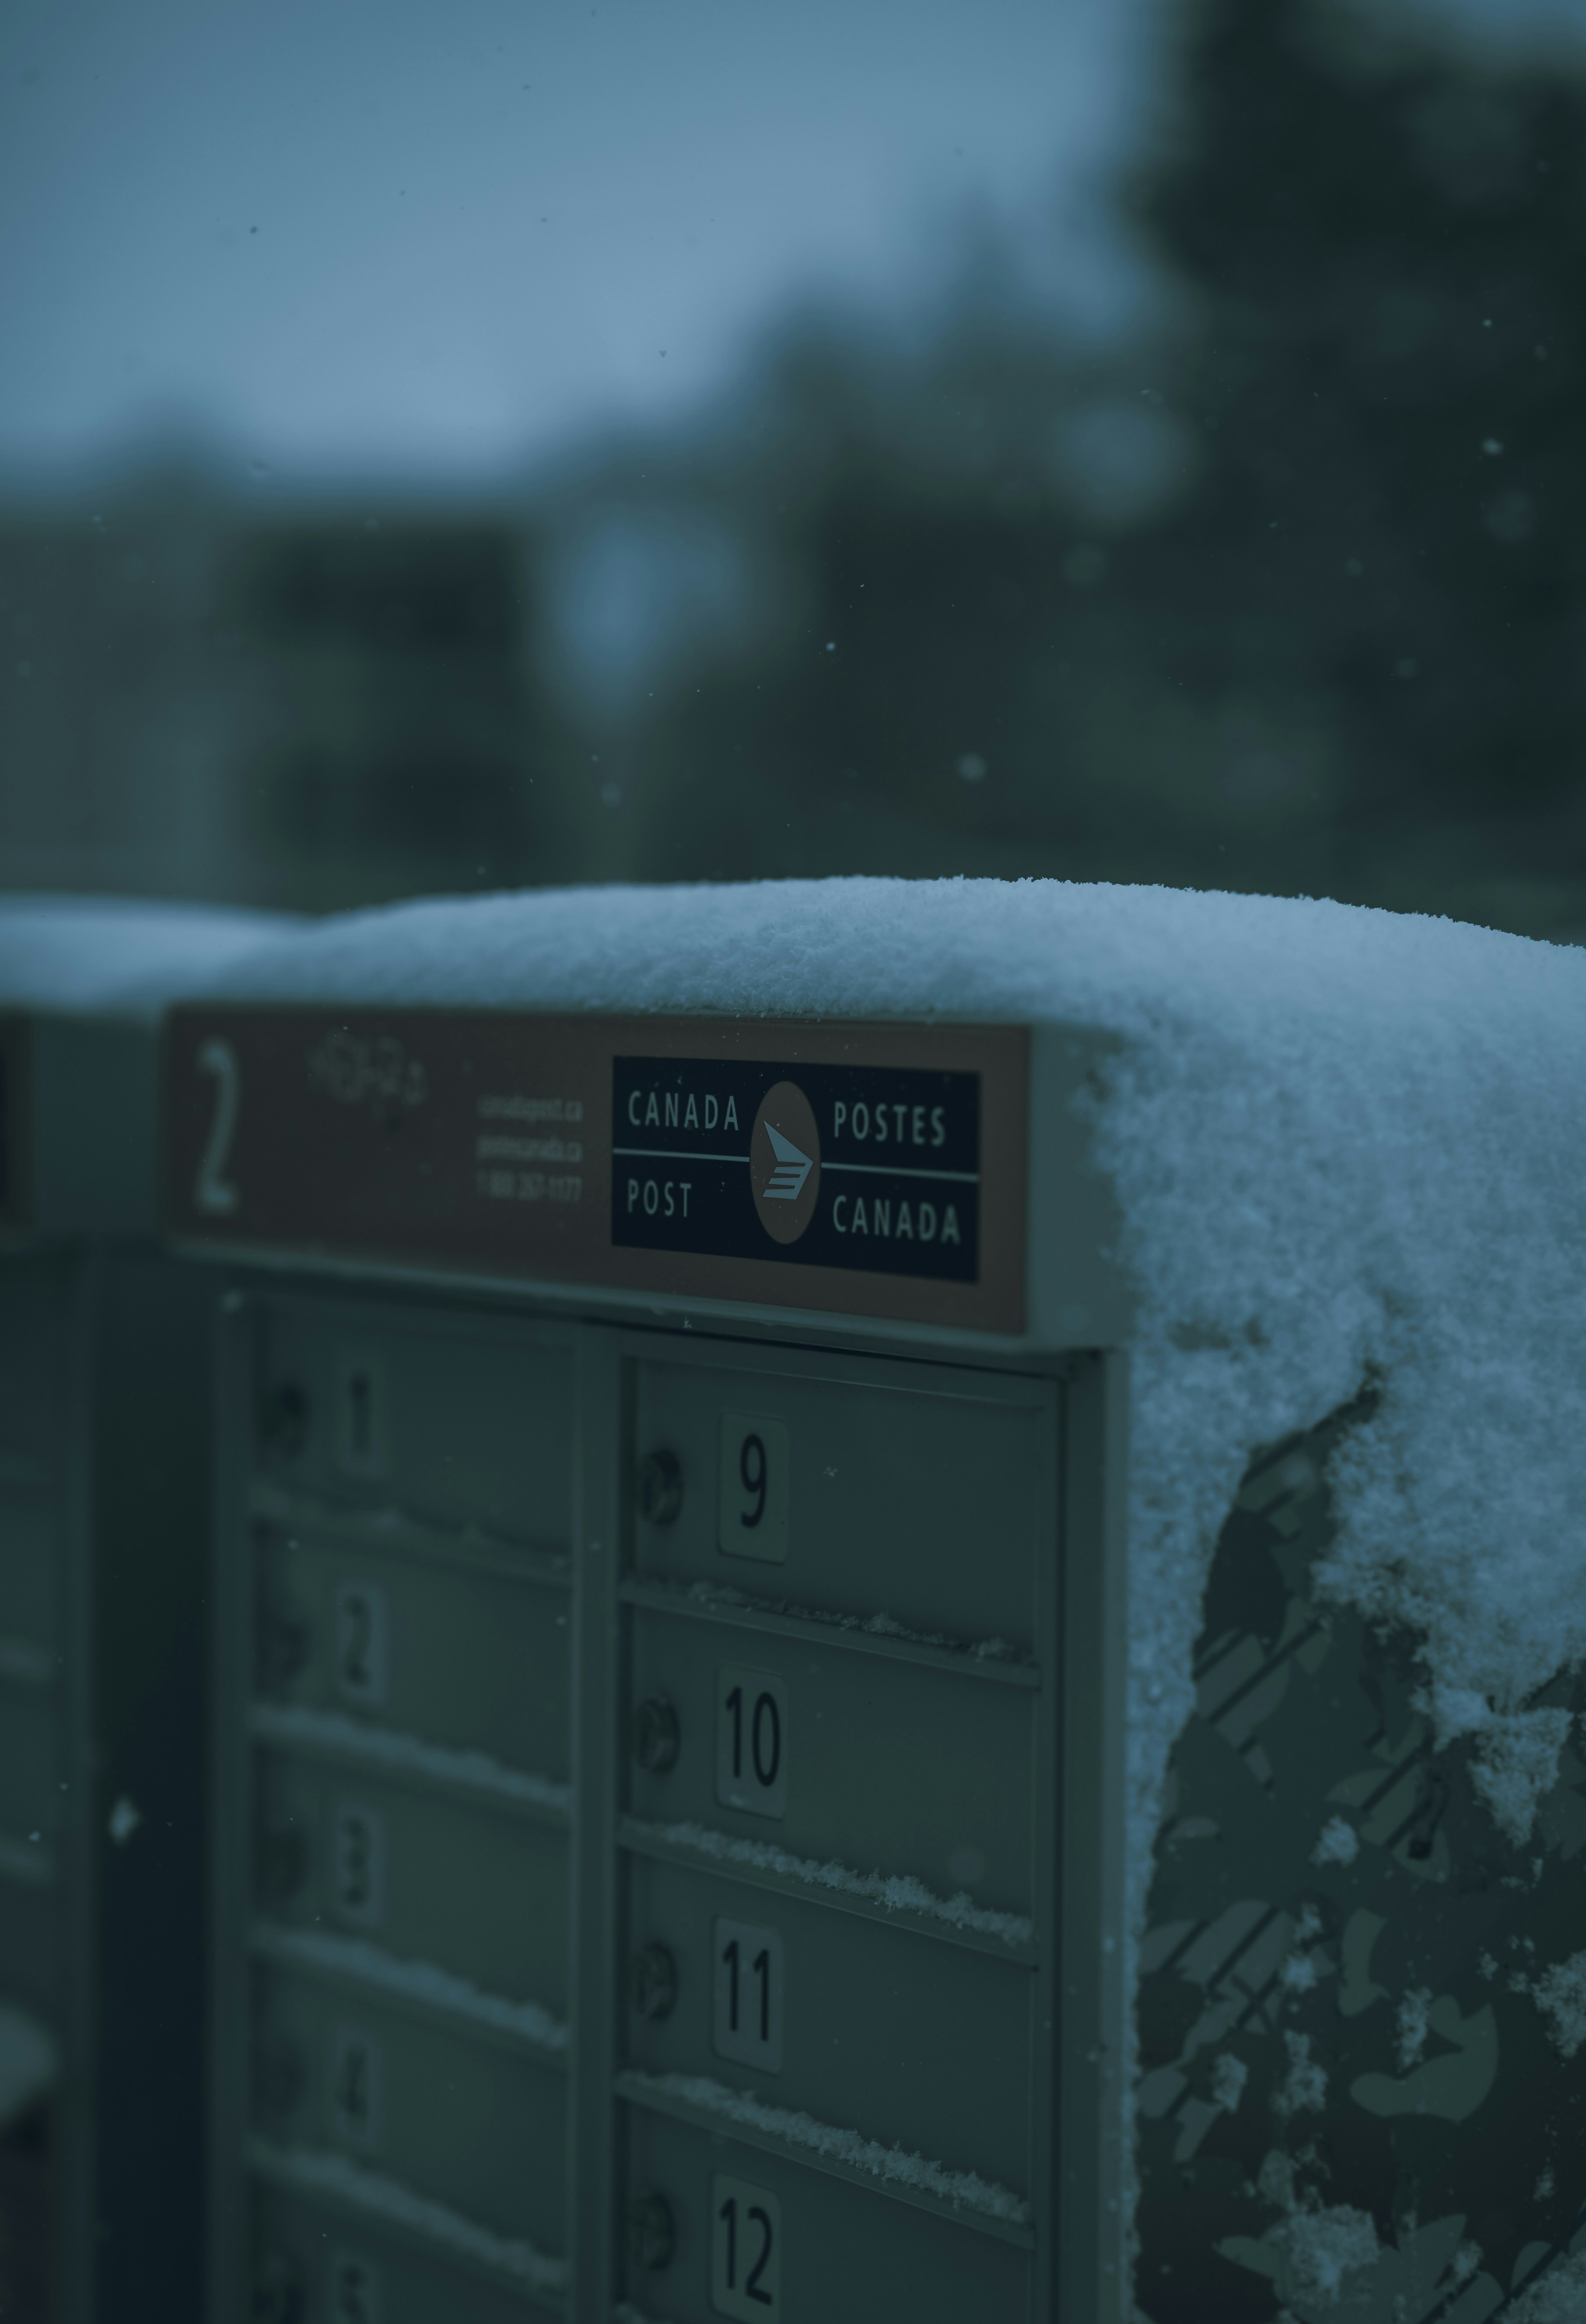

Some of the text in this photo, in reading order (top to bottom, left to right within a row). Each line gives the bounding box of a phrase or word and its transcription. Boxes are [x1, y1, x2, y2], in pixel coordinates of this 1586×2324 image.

[196, 1037, 241, 1214] 2
[628, 1090, 739, 1132] CANADA
[833, 1101, 945, 1146] POSTES
[627, 1178, 692, 1217] POST
[832, 1195, 961, 1244] CANADA
[349, 1371, 372, 1455] 1
[739, 1433, 767, 1529] 9
[343, 1593, 373, 1688] 2
[725, 1686, 781, 1788] 10
[343, 1816, 371, 1908] 3
[722, 1939, 770, 2042] 11
[720, 2198, 773, 2306] 12
